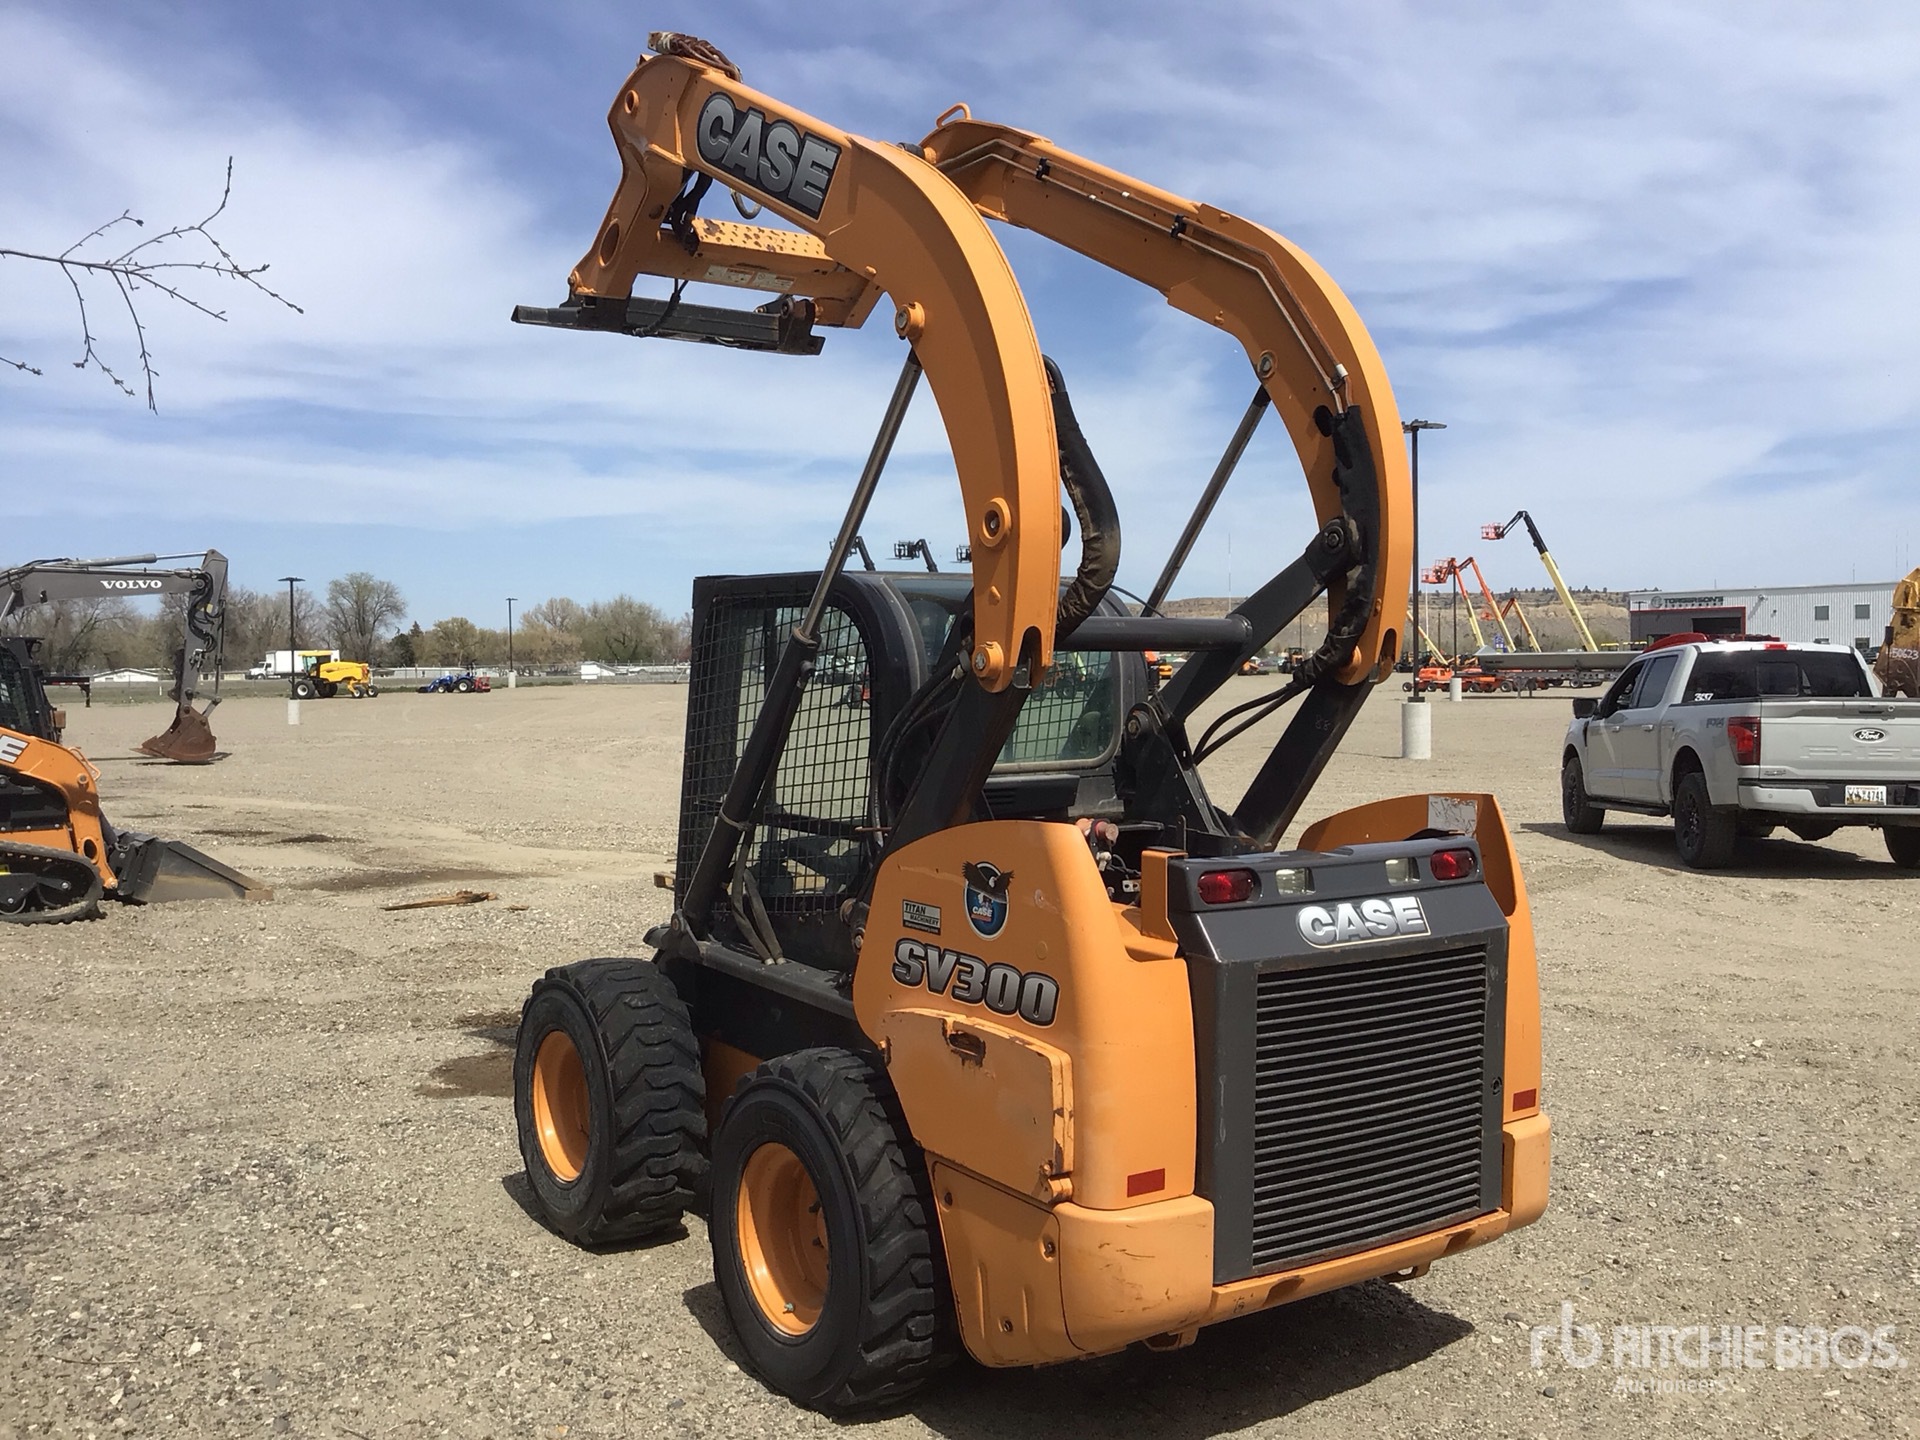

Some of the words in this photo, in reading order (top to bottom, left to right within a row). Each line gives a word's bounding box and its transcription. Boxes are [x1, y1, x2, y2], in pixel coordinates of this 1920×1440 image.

[698, 94, 841, 217] CASE
[100, 579, 162, 589] VOLVO
[904, 902, 926, 915] TITAN
[972, 906, 993, 917] CASE
[910, 914, 939, 926] MACHINERY
[1298, 896, 1427, 945] CASE
[892, 938, 1060, 1028] SV300
